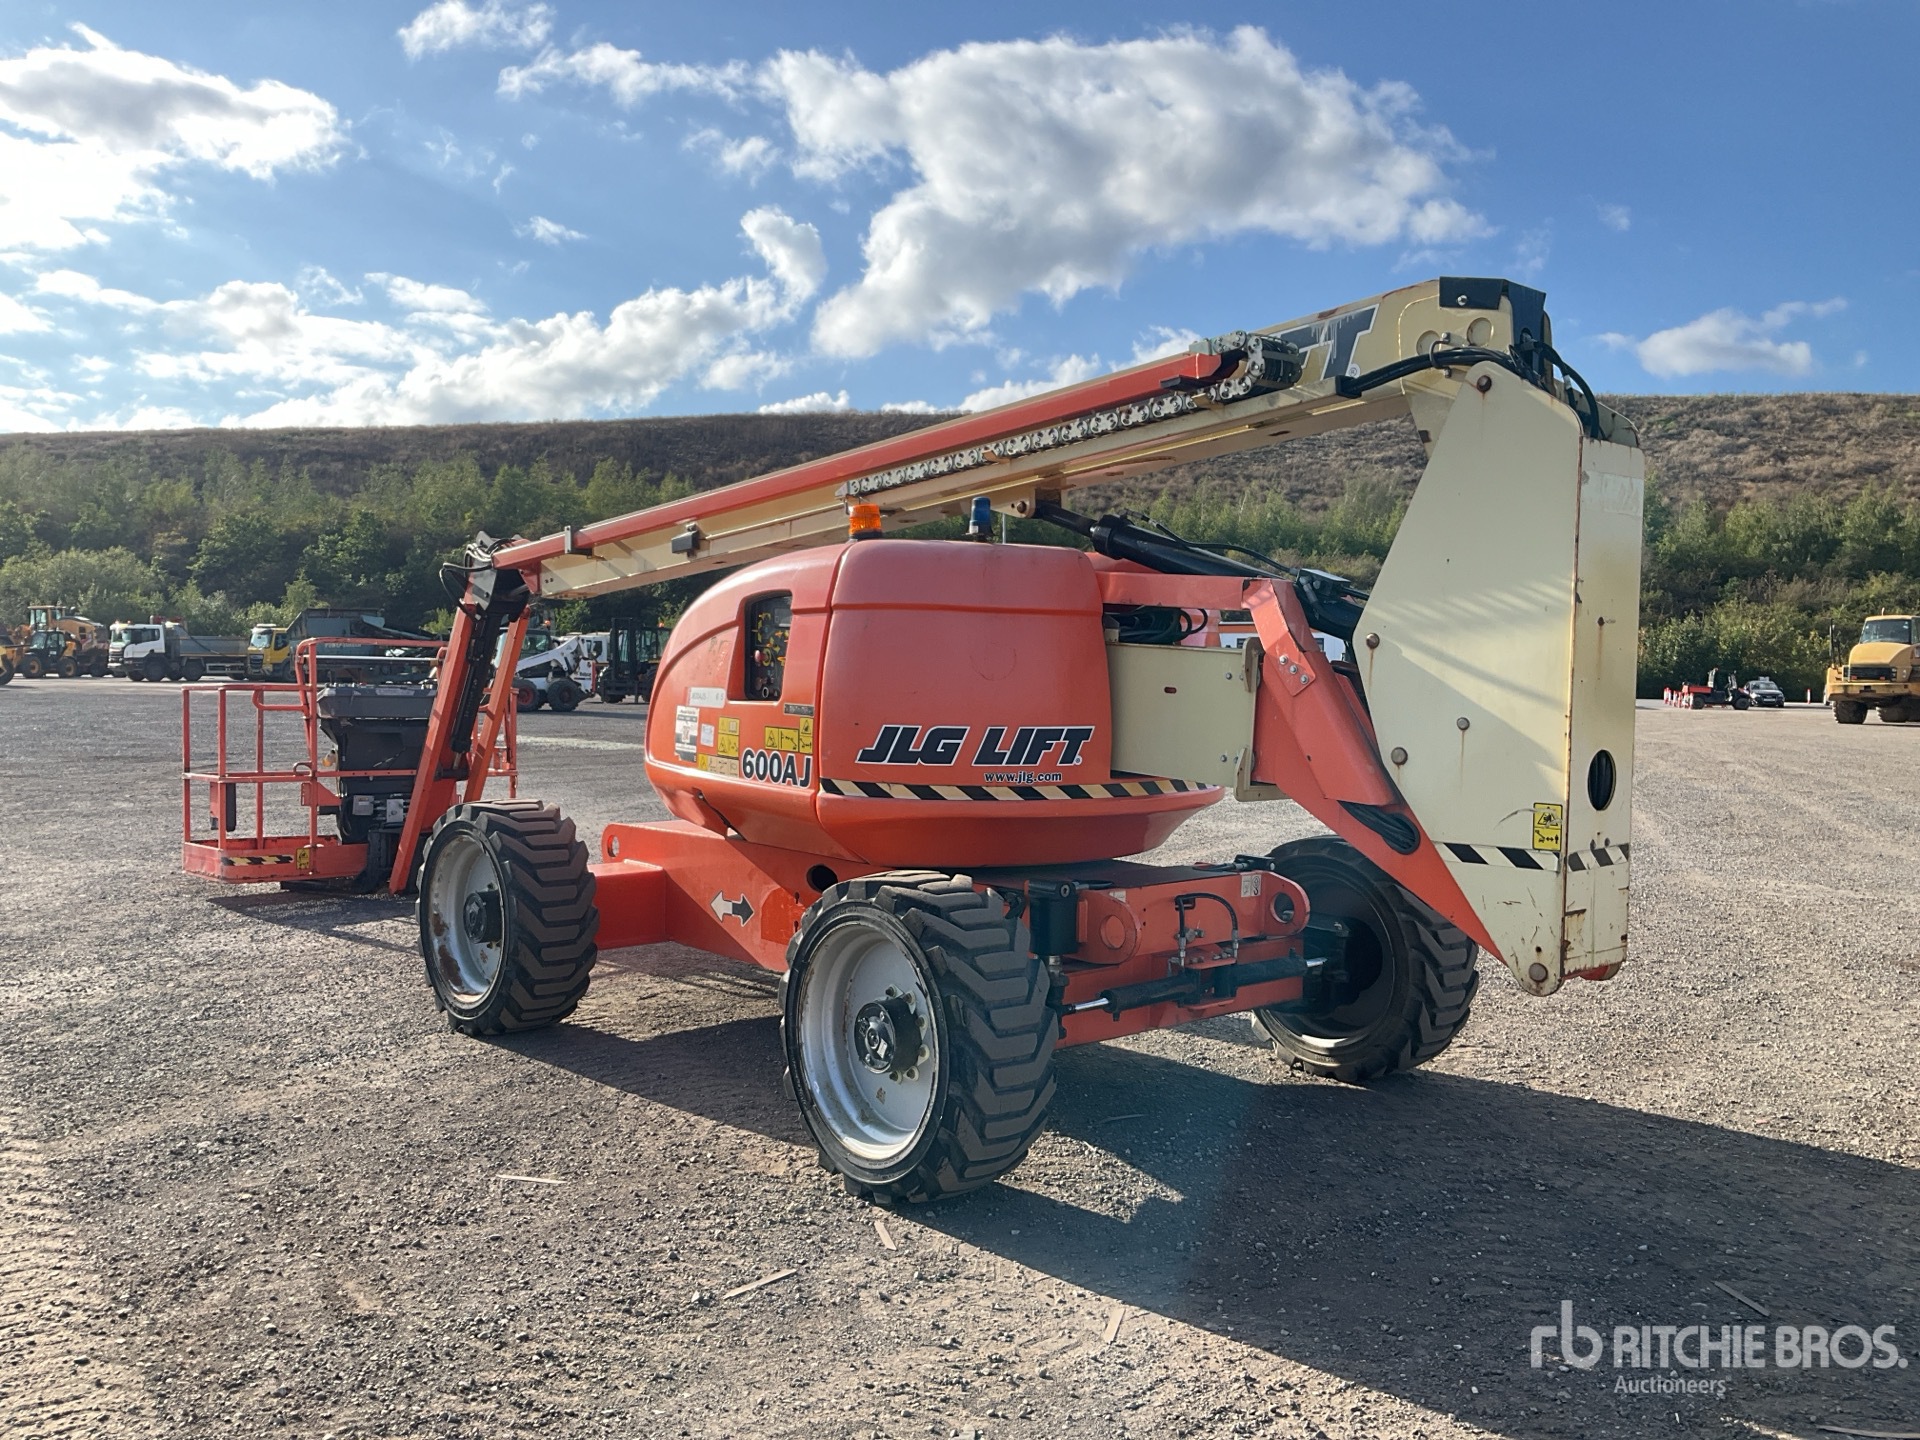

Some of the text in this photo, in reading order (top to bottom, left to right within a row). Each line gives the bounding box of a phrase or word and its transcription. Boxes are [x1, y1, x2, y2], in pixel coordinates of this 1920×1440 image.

[855, 724, 970, 765] JLG
[742, 748, 813, 788] 600AJ
[984, 771, 1062, 783] www.jlg.com
